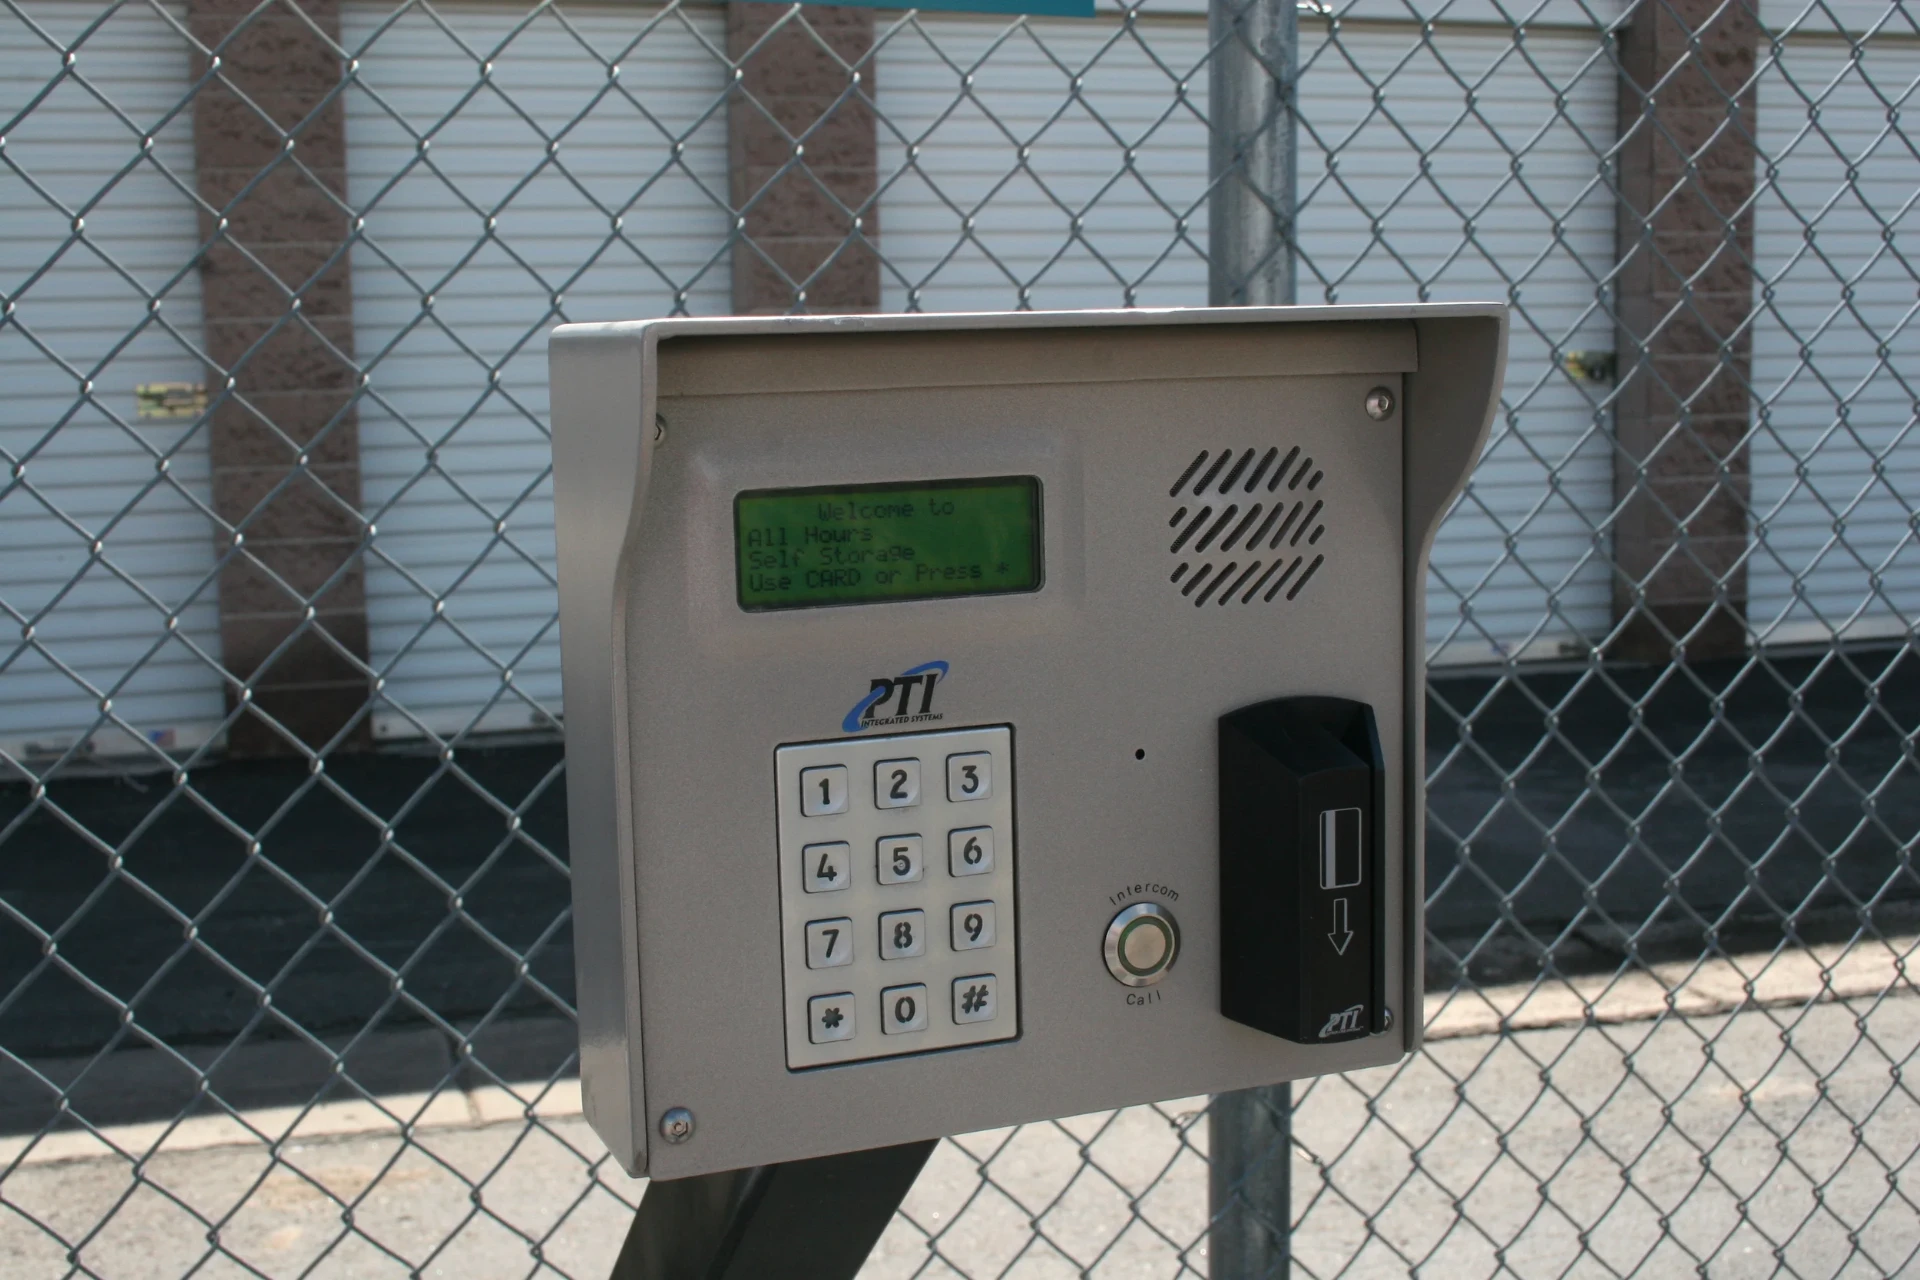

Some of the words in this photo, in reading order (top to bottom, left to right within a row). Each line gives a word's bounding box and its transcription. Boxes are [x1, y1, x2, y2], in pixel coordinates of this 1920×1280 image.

[818, 501, 914, 521] Welcome
[929, 499, 955, 517] to
[748, 527, 788, 547] All
[804, 526, 873, 544] Hours
[748, 549, 804, 570] Self
[820, 545, 916, 566] Storage
[750, 572, 792, 592] Use
[806, 569, 861, 588] CARD
[875, 569, 902, 585] or
[916, 563, 982, 582] Press
[862, 673, 939, 719] PTI
[860, 715, 909, 729] INTEGRATED
[911, 713, 944, 724] SYSTEMS
[819, 778, 830, 805] 1
[890, 769, 908, 799] 2
[961, 765, 979, 793] 3
[816, 853, 837, 881] 4
[892, 847, 911, 876] 5
[963, 836, 982, 865] 6
[1109, 883, 1179, 906] Intercom
[822, 929, 839, 958] 7
[894, 922, 912, 948] 8
[964, 913, 983, 941] 9
[895, 996, 915, 1023] 0
[962, 984, 989, 1014] #
[1126, 990, 1161, 1006] Call
[1326, 1010, 1359, 1032] PTI
